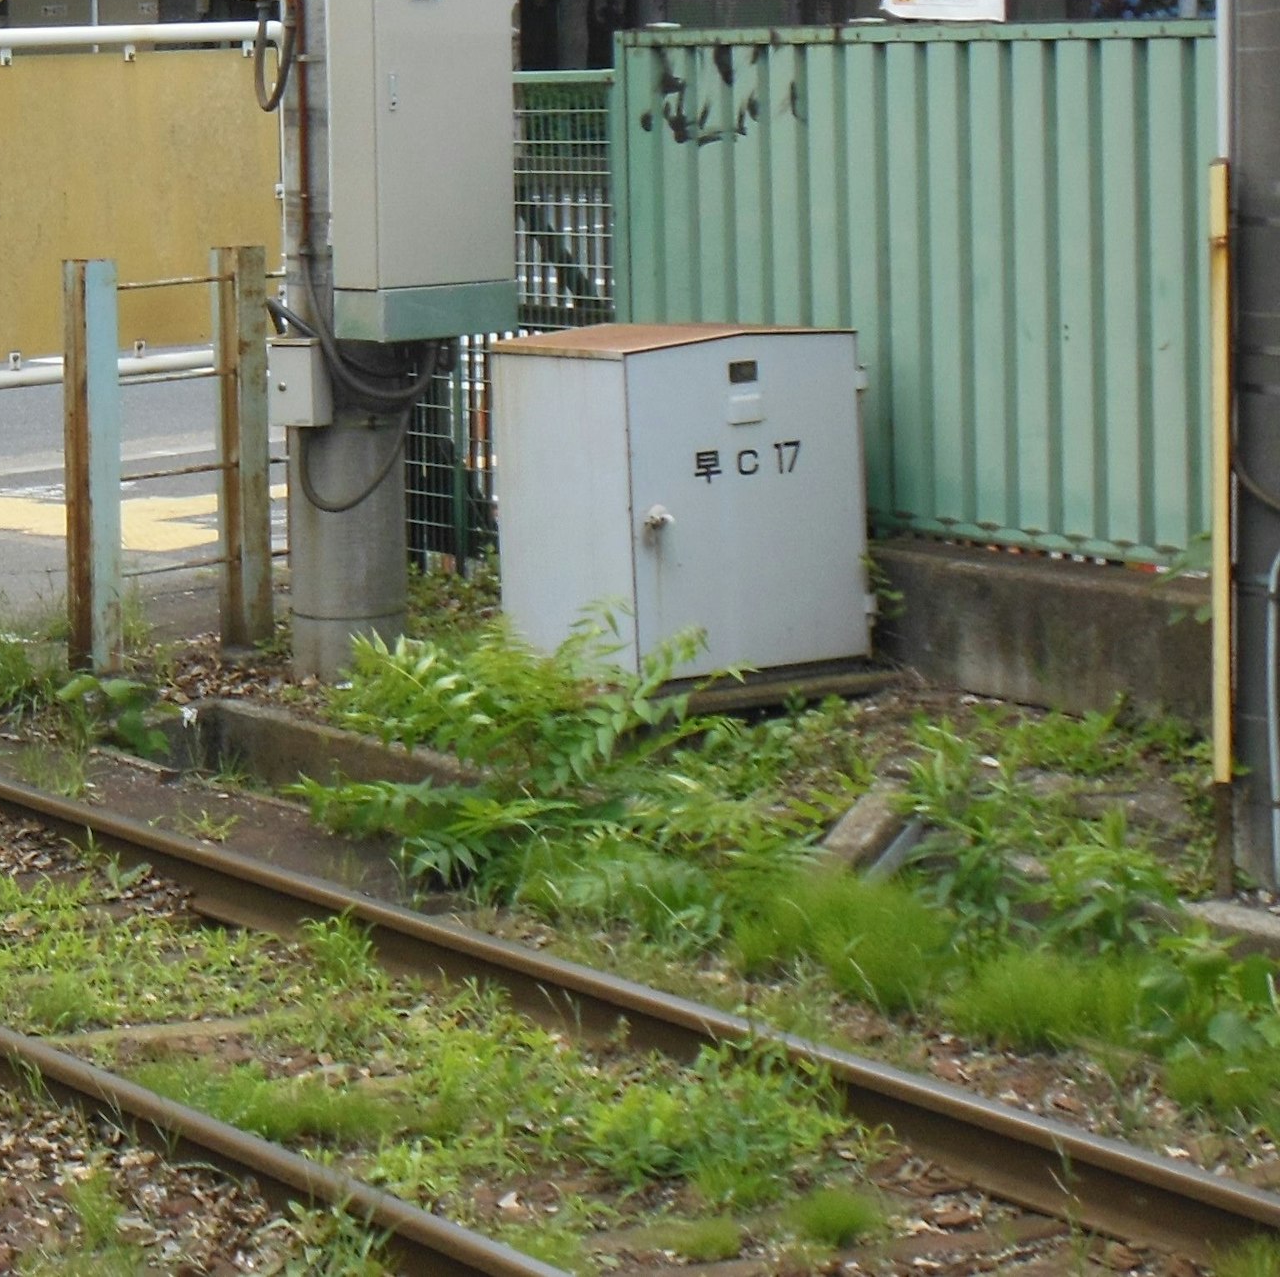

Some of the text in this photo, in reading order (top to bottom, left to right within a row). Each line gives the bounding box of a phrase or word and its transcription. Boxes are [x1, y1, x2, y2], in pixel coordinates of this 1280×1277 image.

[692, 439, 802, 484] 早 C 17
